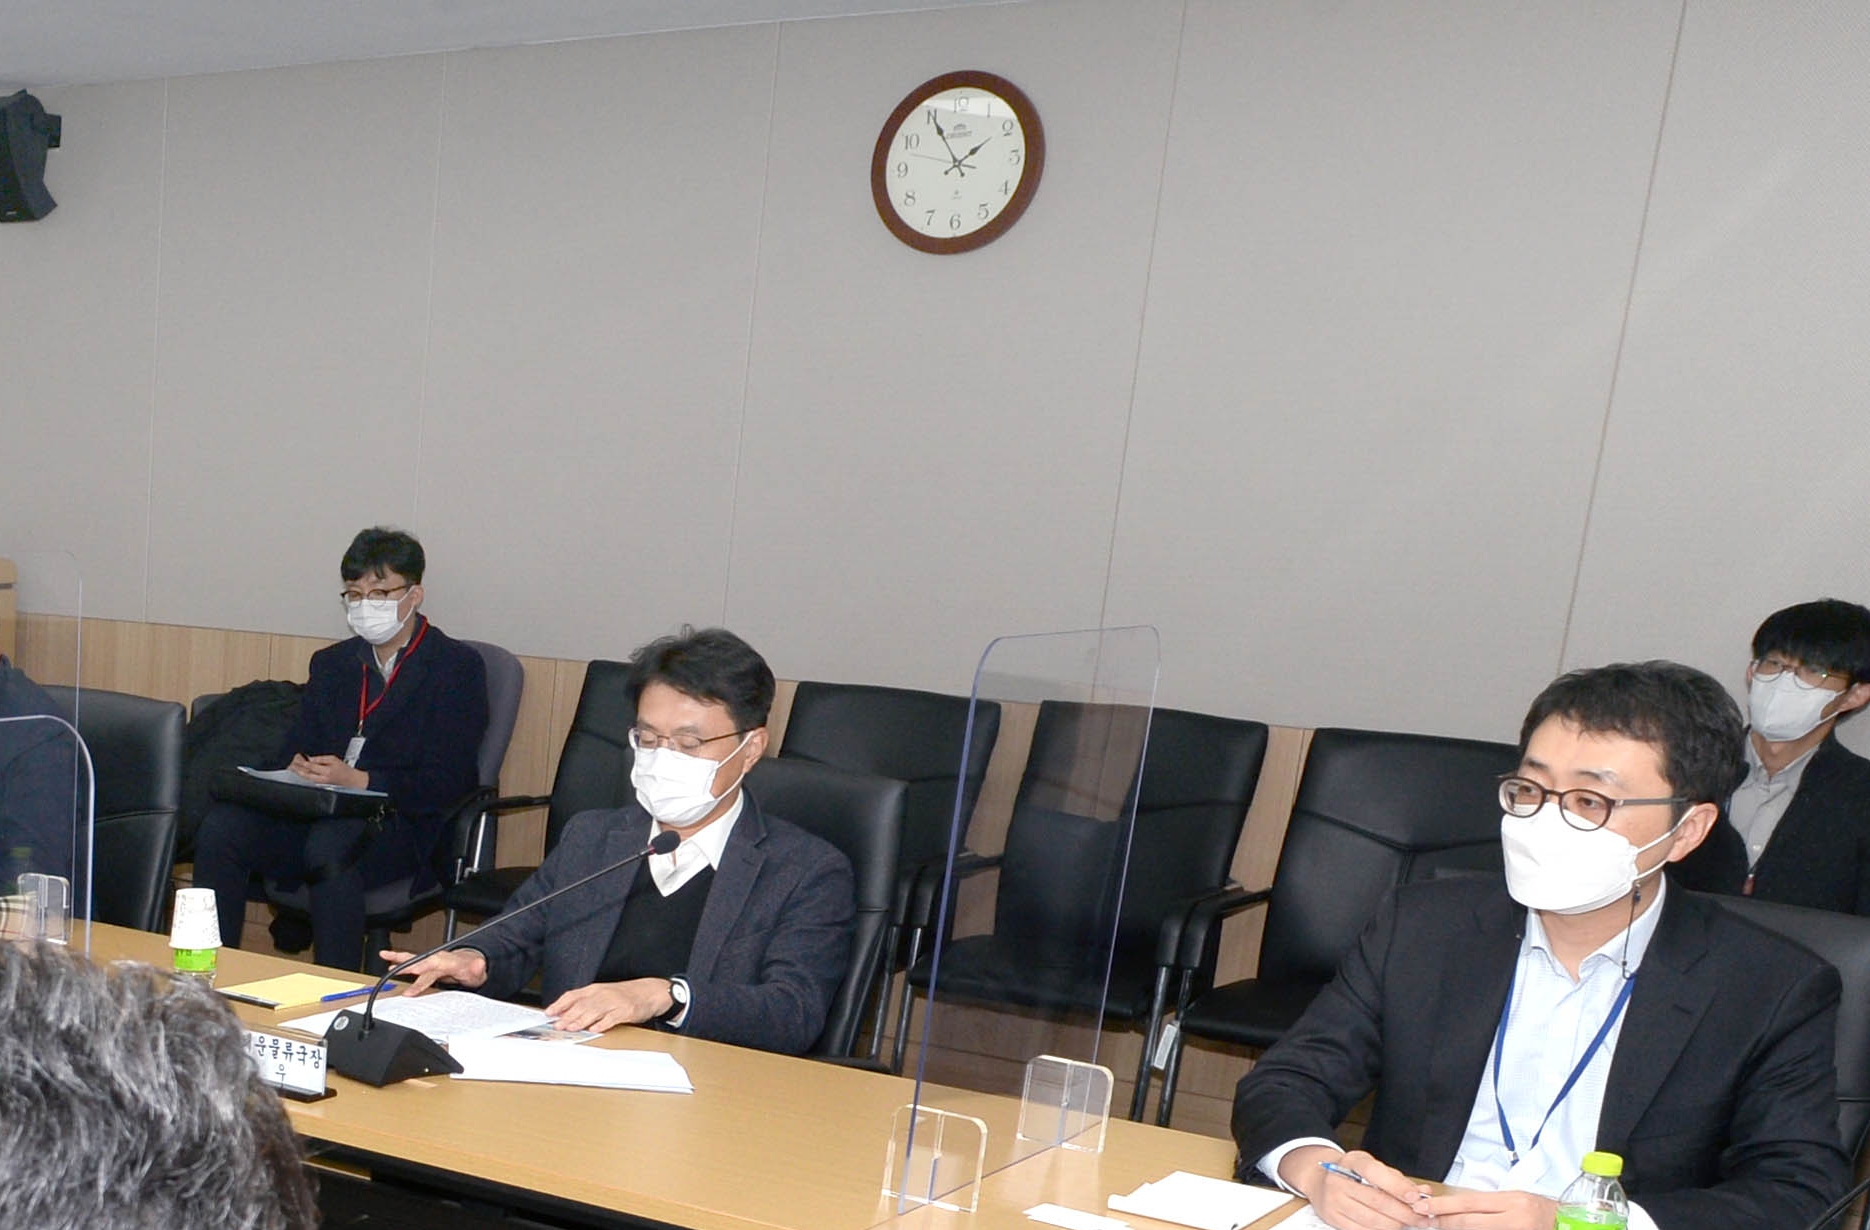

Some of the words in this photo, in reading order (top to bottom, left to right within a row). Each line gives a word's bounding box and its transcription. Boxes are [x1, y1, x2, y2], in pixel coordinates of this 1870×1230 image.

[954, 96, 970, 113] 12
[986, 102, 992, 118] 1
[1002, 119, 1014, 137] 2
[905, 134, 920, 151] 10
[1009, 149, 1021, 166] 3
[897, 162, 909, 179] 9
[998, 180, 1010, 196] 4
[904, 190, 916, 207] 8
[925, 209, 936, 227] 7
[977, 203, 990, 221] 5
[949, 213, 962, 231] 6
[254, 1036, 323, 1069] 운물류국장
[275, 1064, 286, 1083] 우
